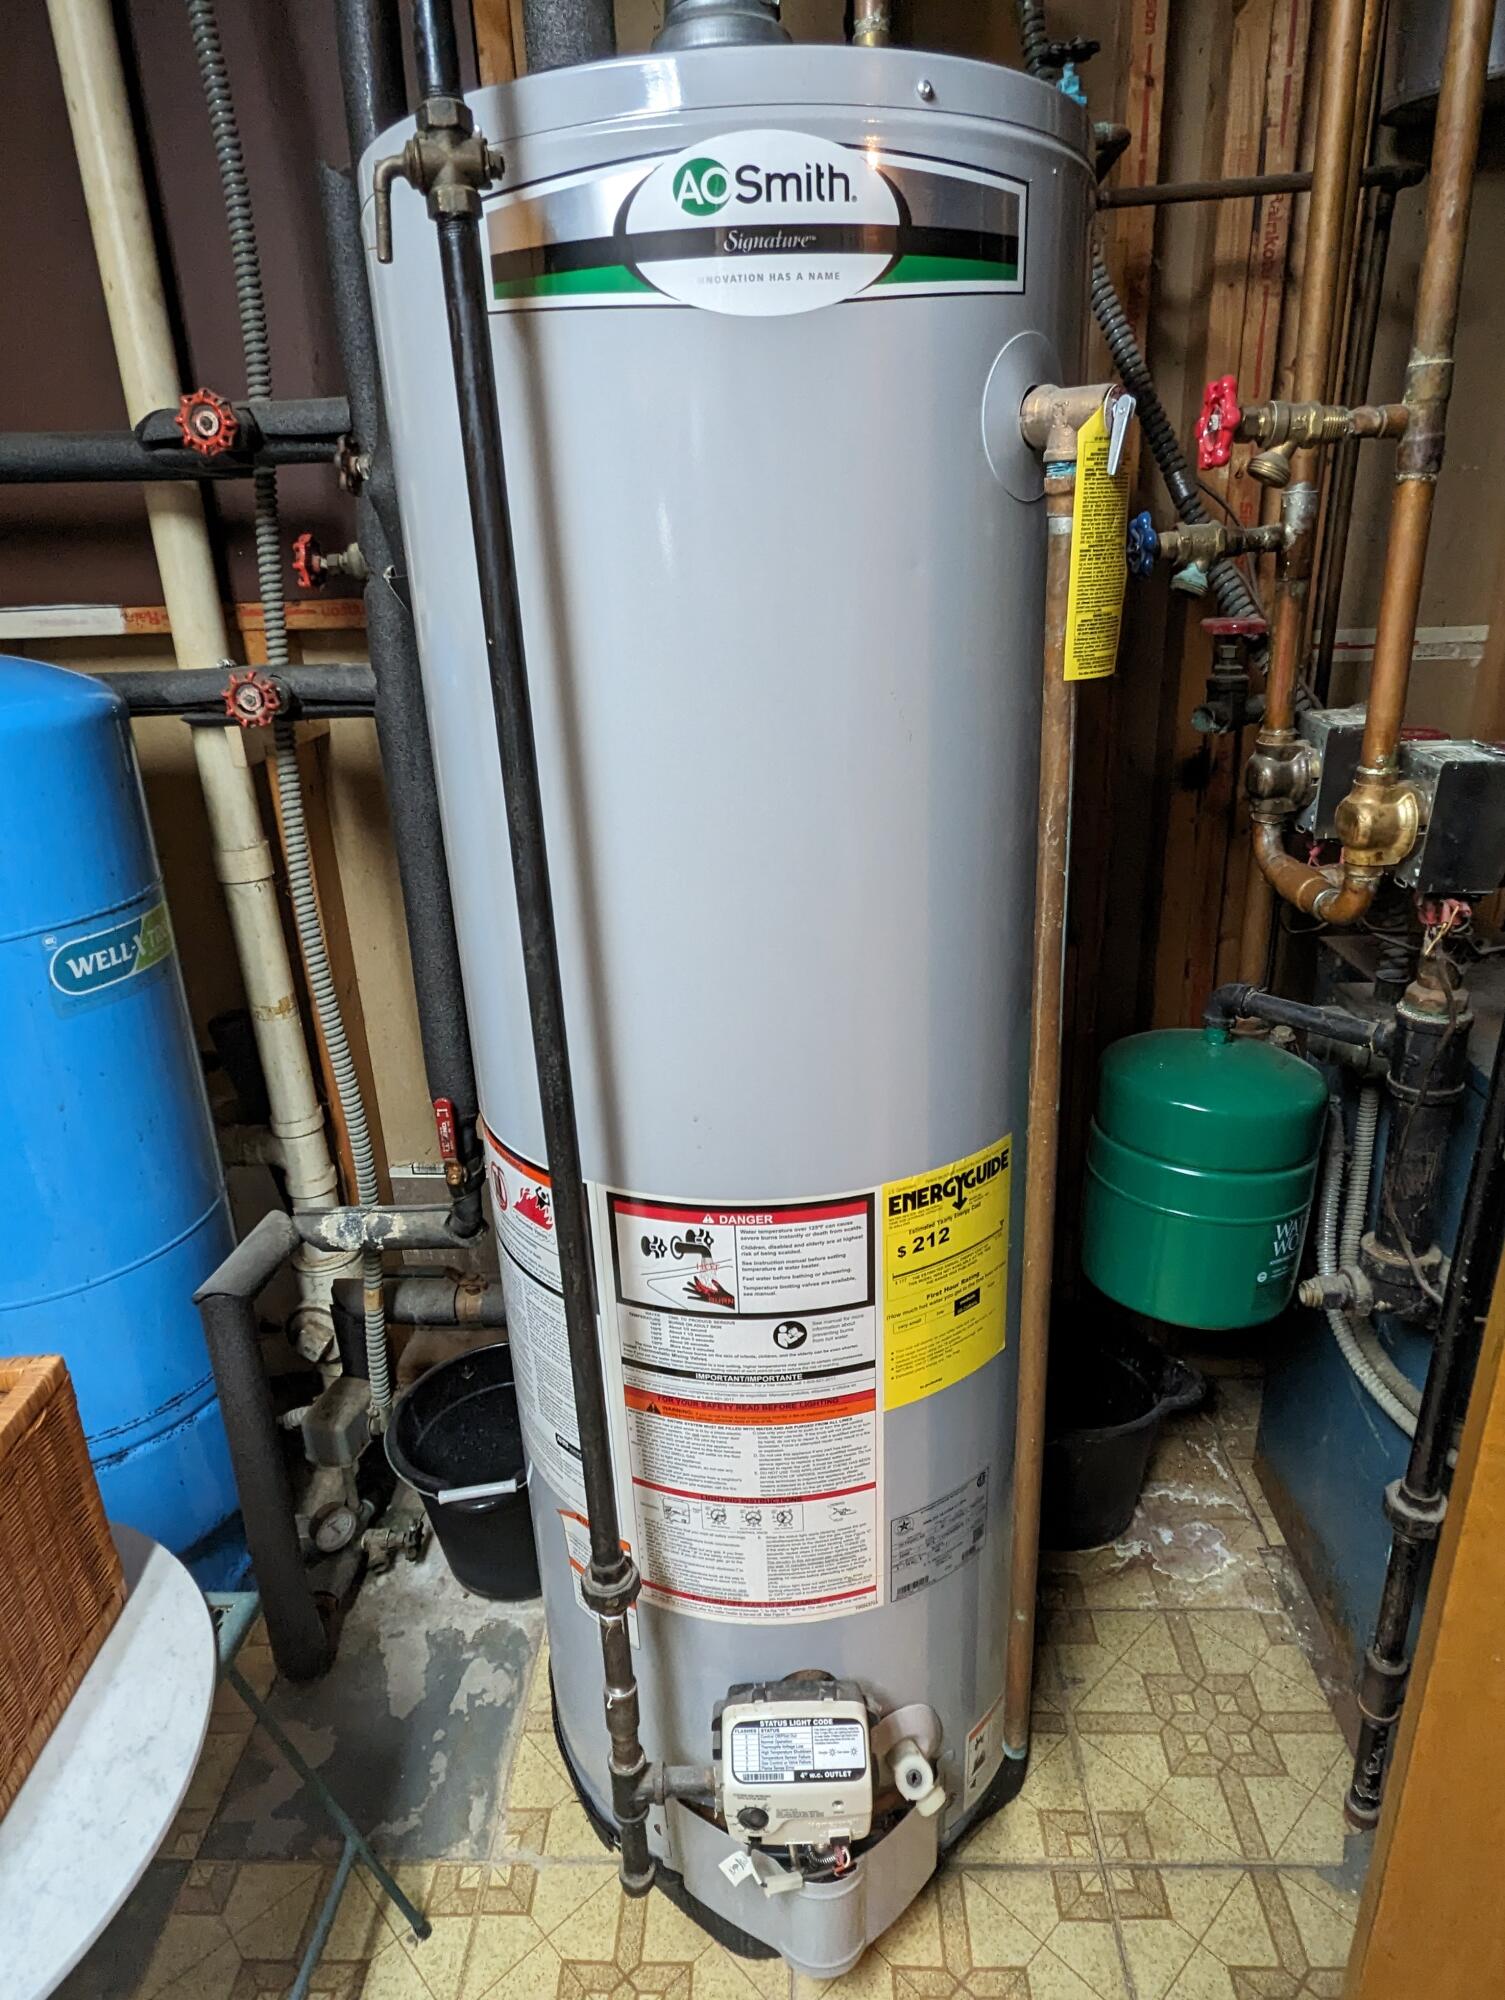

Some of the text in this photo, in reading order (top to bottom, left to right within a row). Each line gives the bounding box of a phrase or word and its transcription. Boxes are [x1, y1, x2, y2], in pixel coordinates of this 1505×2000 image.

[735, 162, 850, 204] Smith
[769, 272, 791, 281] HAS
[796, 272, 803, 280] A
[808, 272, 840, 280] NAME
[889, 1148, 1009, 1217] ENERGYGUIDE
[719, 1214, 774, 1225] DANGER
[909, 1221, 936, 1235] Estimated
[954, 1208, 971, 1219] Energy
[971, 1202, 981, 1213] Cost
[806, 1240, 825, 1248] elderly
[843, 1234, 863, 1242] highest
[897, 1227, 950, 1258] $ 212
[792, 1272, 814, 1280] bathing
[927, 1291, 942, 1299] First
[944, 1283, 960, 1293] Hour
[961, 1272, 980, 1286] Rating
[919, 1304, 928, 1312] hot
[929, 1298, 943, 1307] water
[695, 1373, 803, 1383] IMPORTANT/IMPORTANTE
[658, 1396, 674, 1404] FOR
[676, 1399, 698, 1407] YOUR
[700, 1401, 734, 1410] SAFETY
[762, 1403, 796, 1411] BEFORE
[798, 1399, 839, 1408] LIGHTING
[759, 1720, 787, 1728] STATUS
